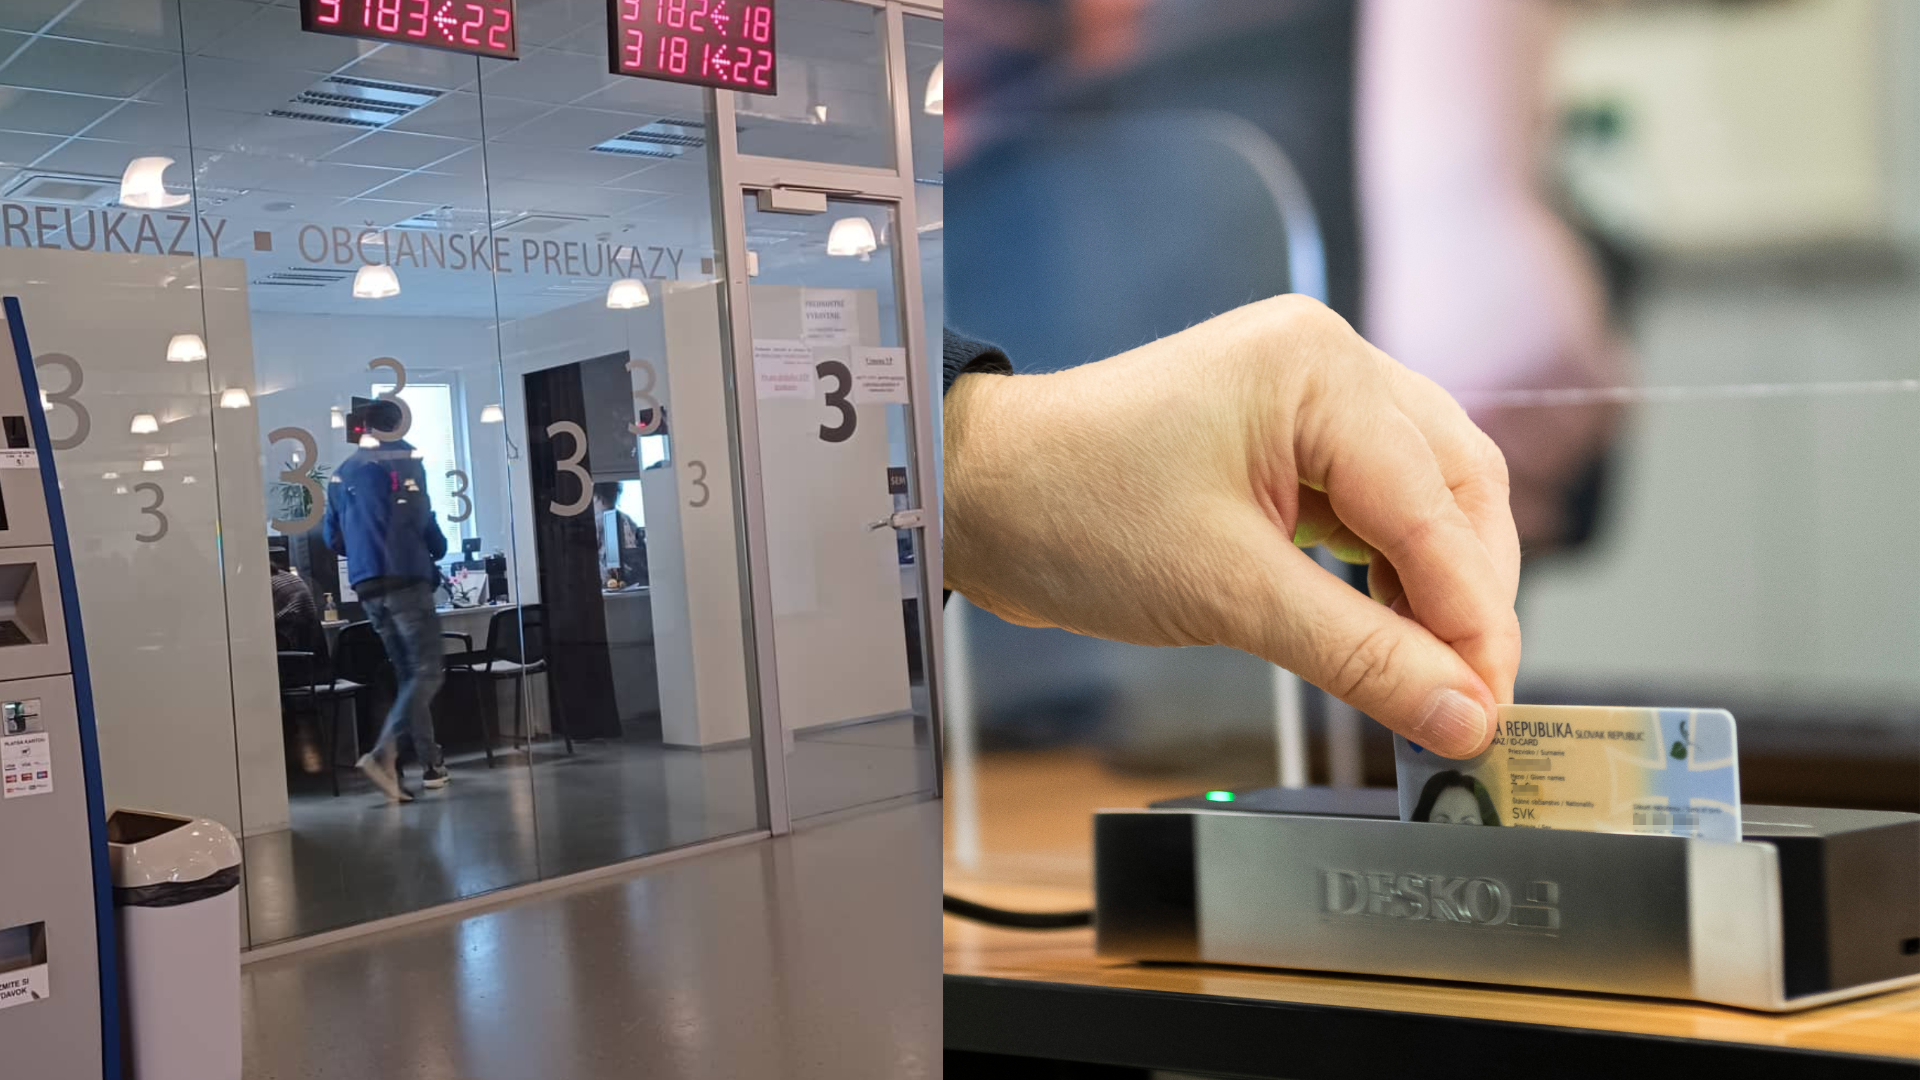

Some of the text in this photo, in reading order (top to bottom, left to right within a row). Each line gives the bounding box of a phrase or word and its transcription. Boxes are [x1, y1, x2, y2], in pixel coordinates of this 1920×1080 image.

[461, 4, 510, 48] 22
[743, 6, 771, 43] 18
[624, 29, 772, 86] 3181 22
[298, 220, 512, 273] OBČIANSKE
[523, 238, 684, 281] PREUKAZY
[35, 353, 91, 450] 3
[368, 357, 412, 441] 3
[625, 358, 663, 436] 3
[815, 360, 858, 443] 3
[267, 426, 325, 534] 3
[445, 469, 473, 523] 3
[545, 420, 594, 517] 3
[687, 460, 710, 508] 3
[133, 482, 169, 543] 3
[1506, 721, 1574, 738] REPUBLIKA
[1575, 730, 1605, 740] SLOVAK
[1512, 807, 1535, 820] SVK
[1316, 867, 1512, 926] DESKO
